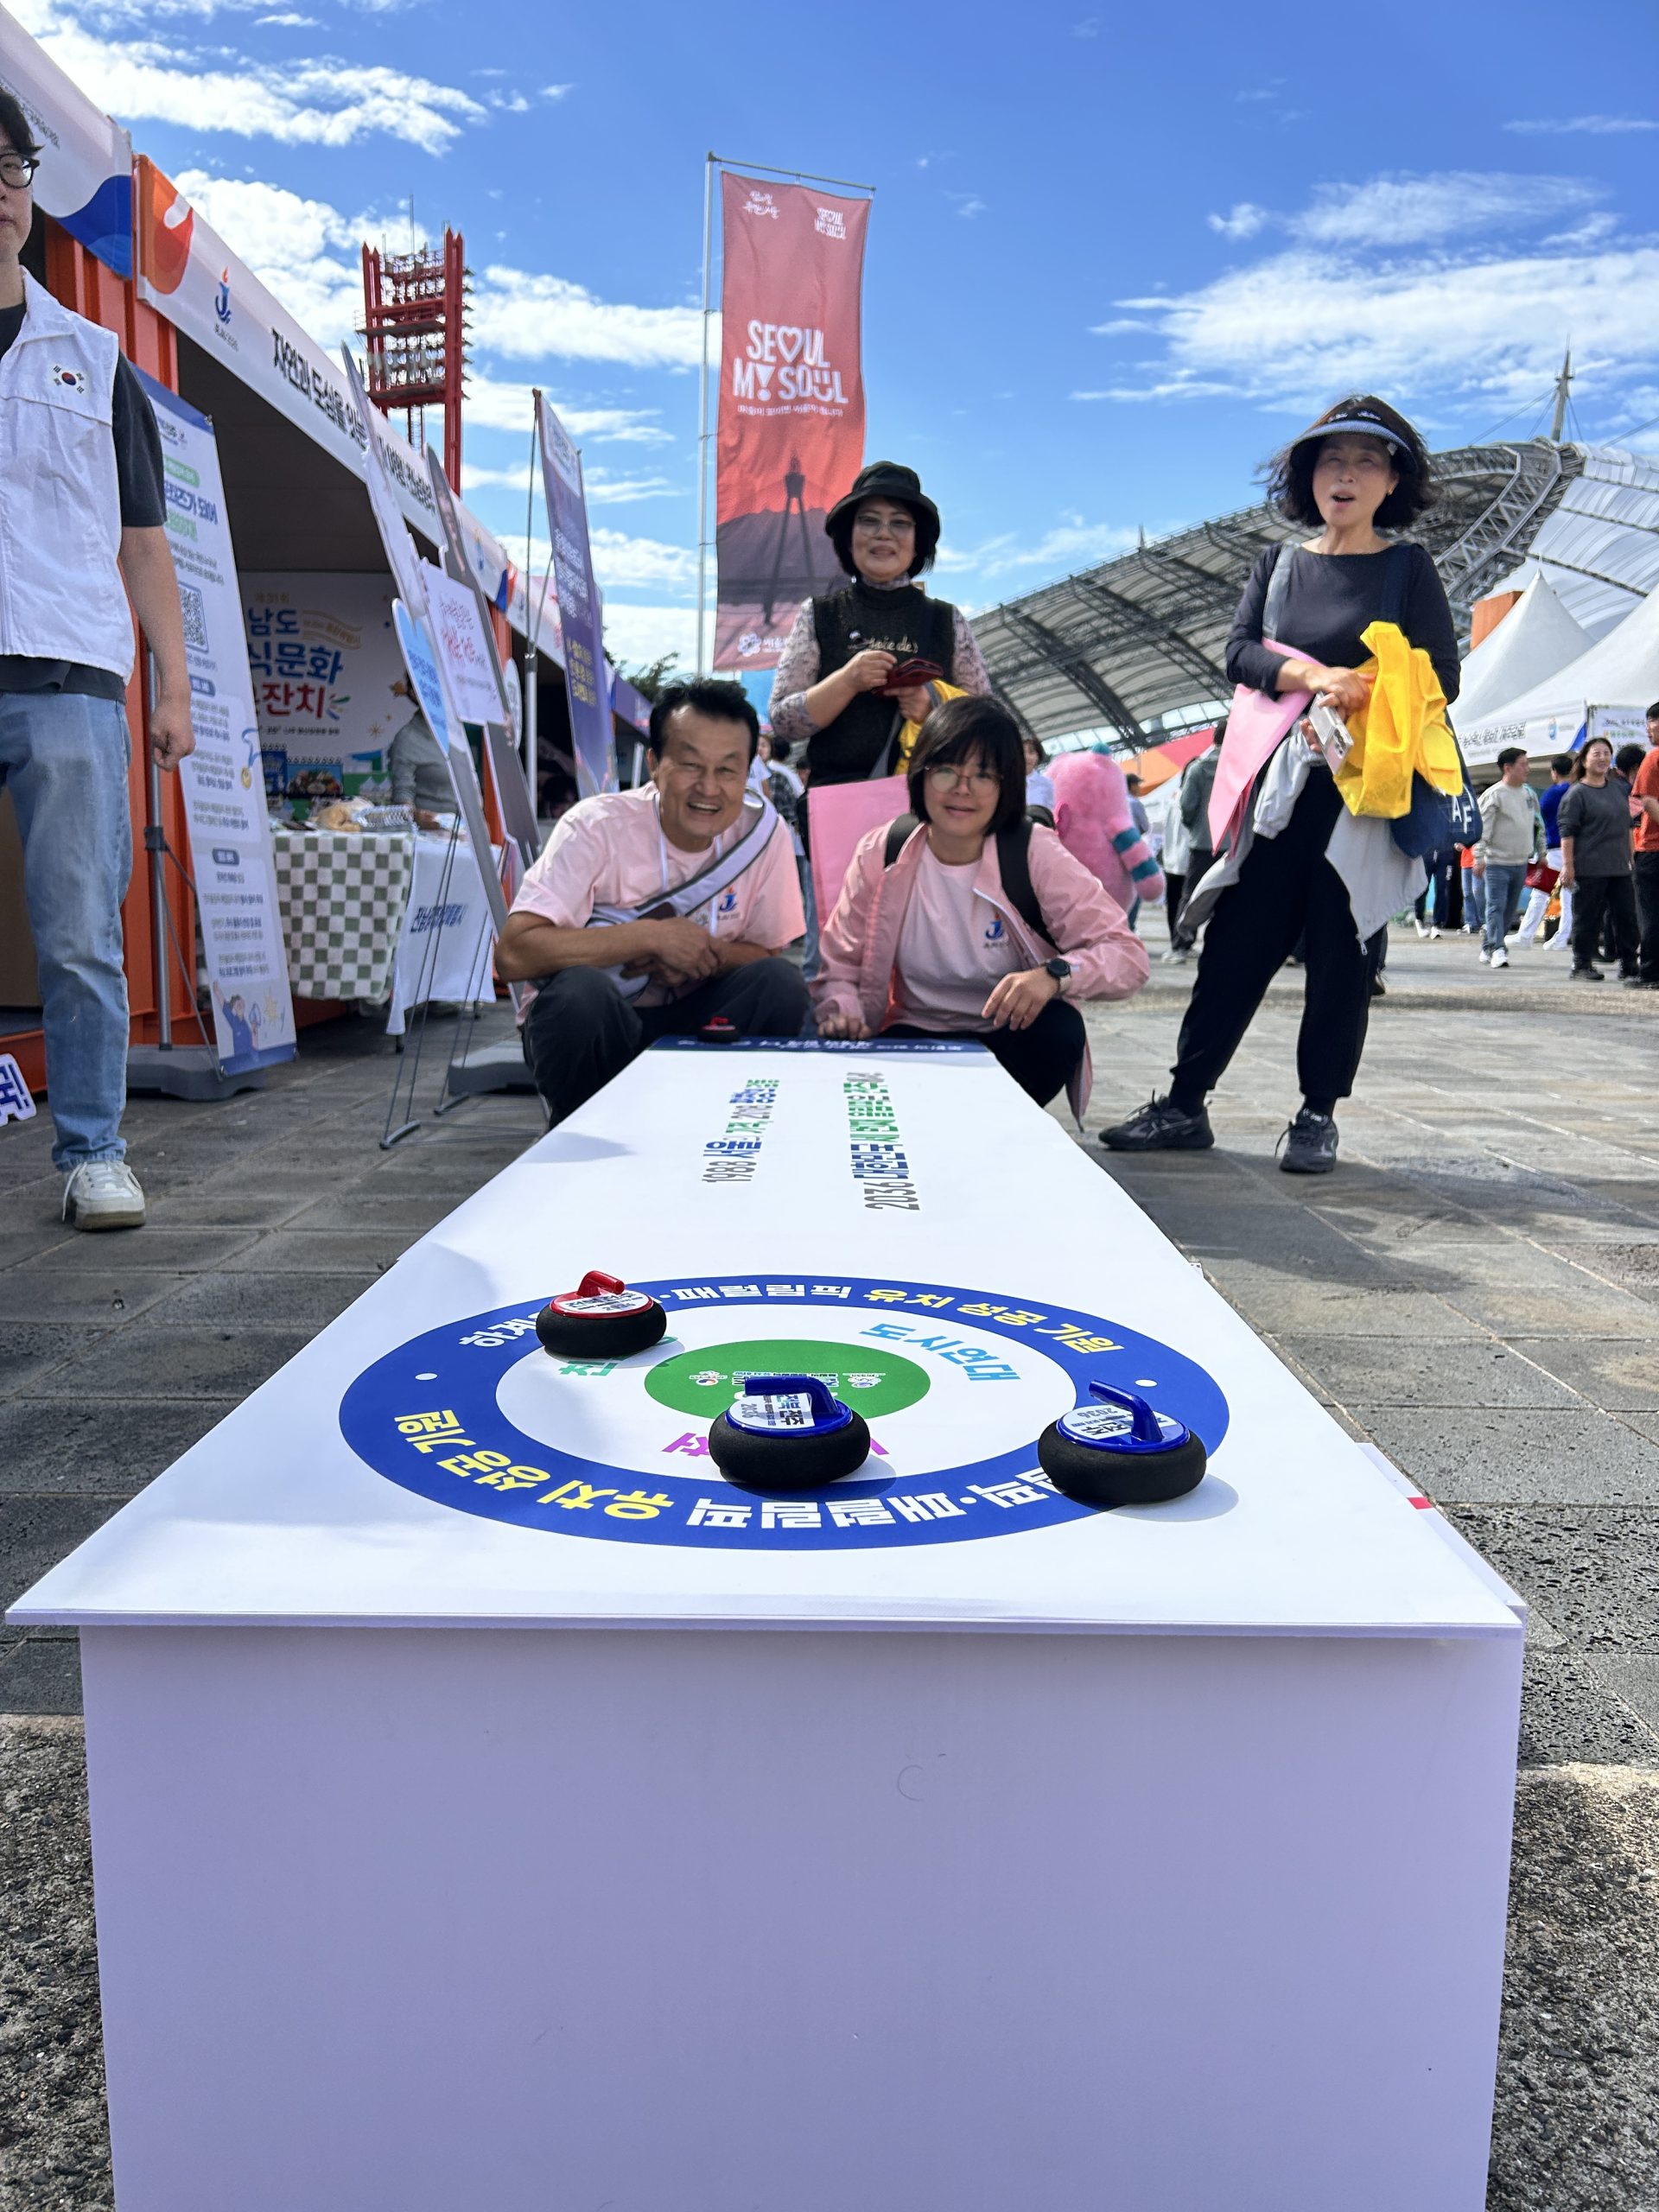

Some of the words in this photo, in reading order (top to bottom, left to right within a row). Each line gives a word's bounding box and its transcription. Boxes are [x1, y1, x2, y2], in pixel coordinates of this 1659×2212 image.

[248, 607, 300, 636] 남도
[253, 683, 326, 719] 잔치
[702, 1160, 757, 1182] 1988
[850, 1143, 910, 1179] 대한민국
[863, 1181, 920, 1211] 2036
[863, 1287, 954, 1308] 유치
[956, 1302, 1041, 1327] 성공
[1045, 1322, 1125, 1354] 기원
[858, 1322, 1021, 1382] 도시연대
[740, 1403, 760, 1419] 2036
[1077, 1408, 1119, 1419] 2036
[394, 1409, 477, 1454] 기원
[435, 1450, 551, 1491] 성공
[536, 1479, 675, 1520] 유치
